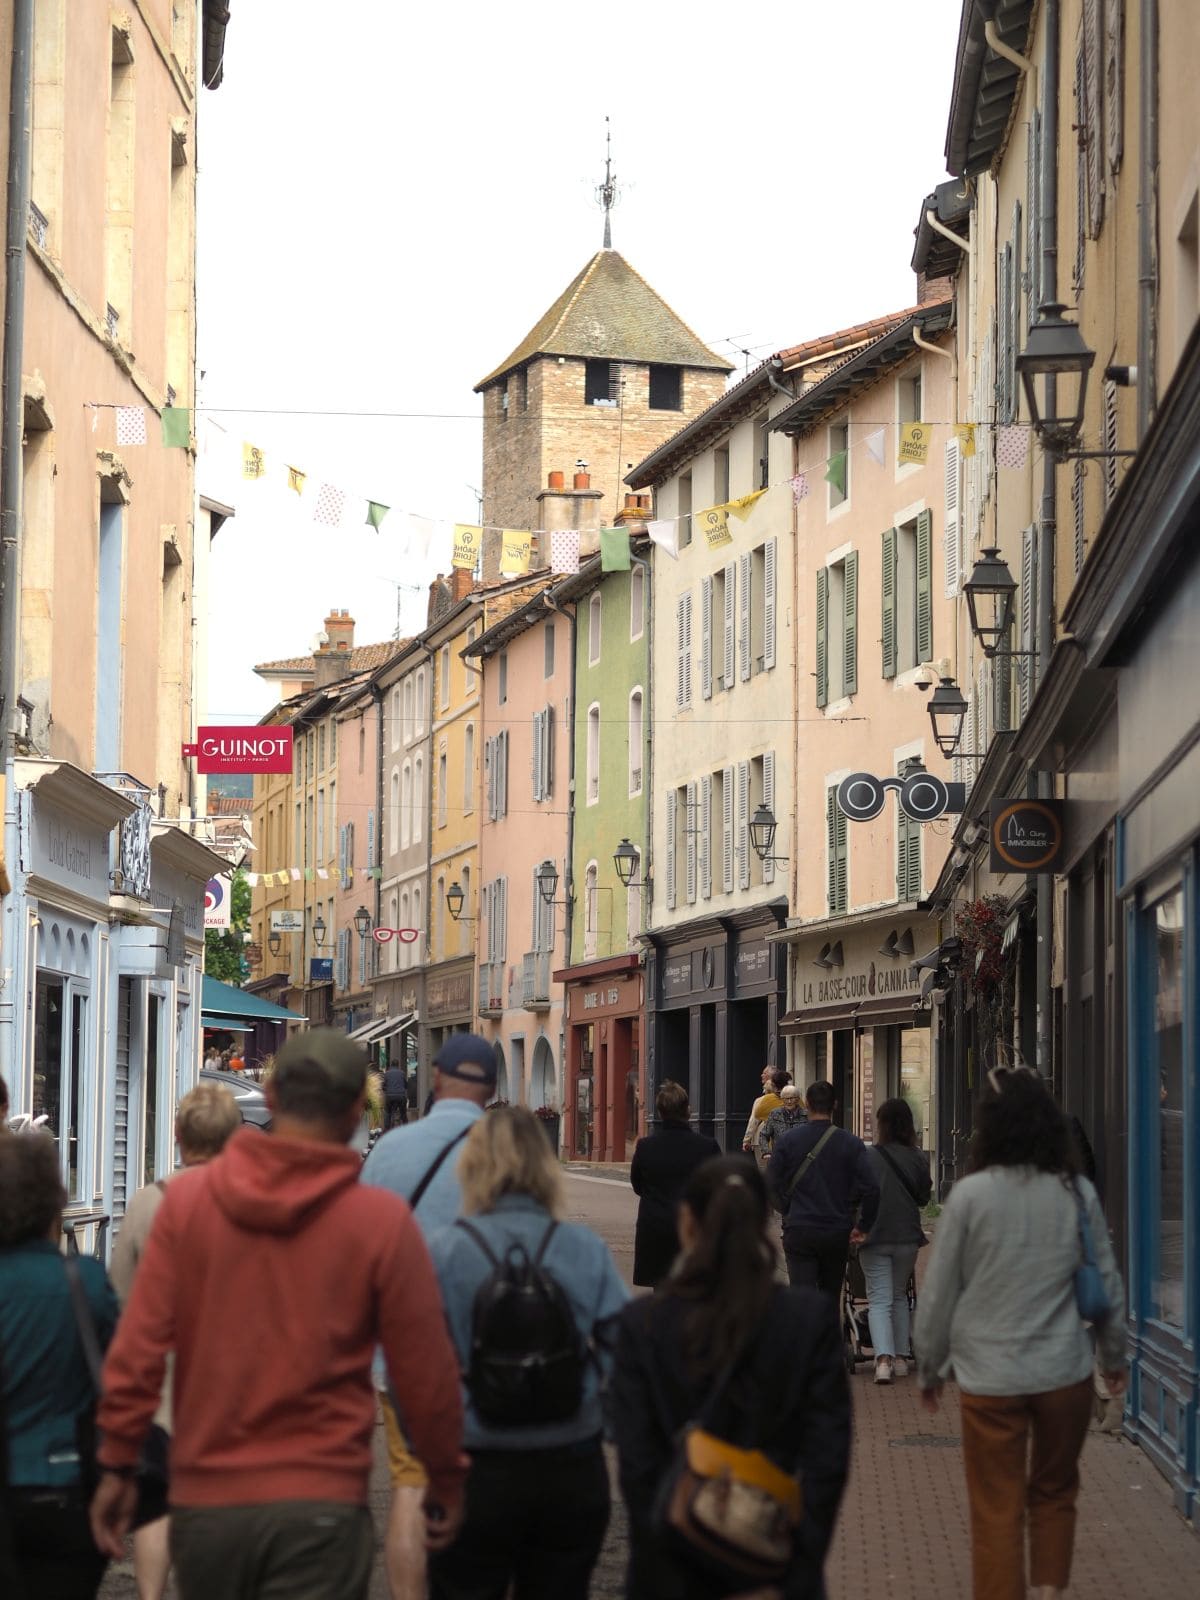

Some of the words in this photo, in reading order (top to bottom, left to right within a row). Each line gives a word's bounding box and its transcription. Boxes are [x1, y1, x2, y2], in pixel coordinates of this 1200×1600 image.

[202, 738, 288, 756] GUINOT
[1007, 839, 1047, 847] IMMOBILIER
[803, 983, 813, 1004] LA
[818, 974, 867, 1002] BASSE-COUR
